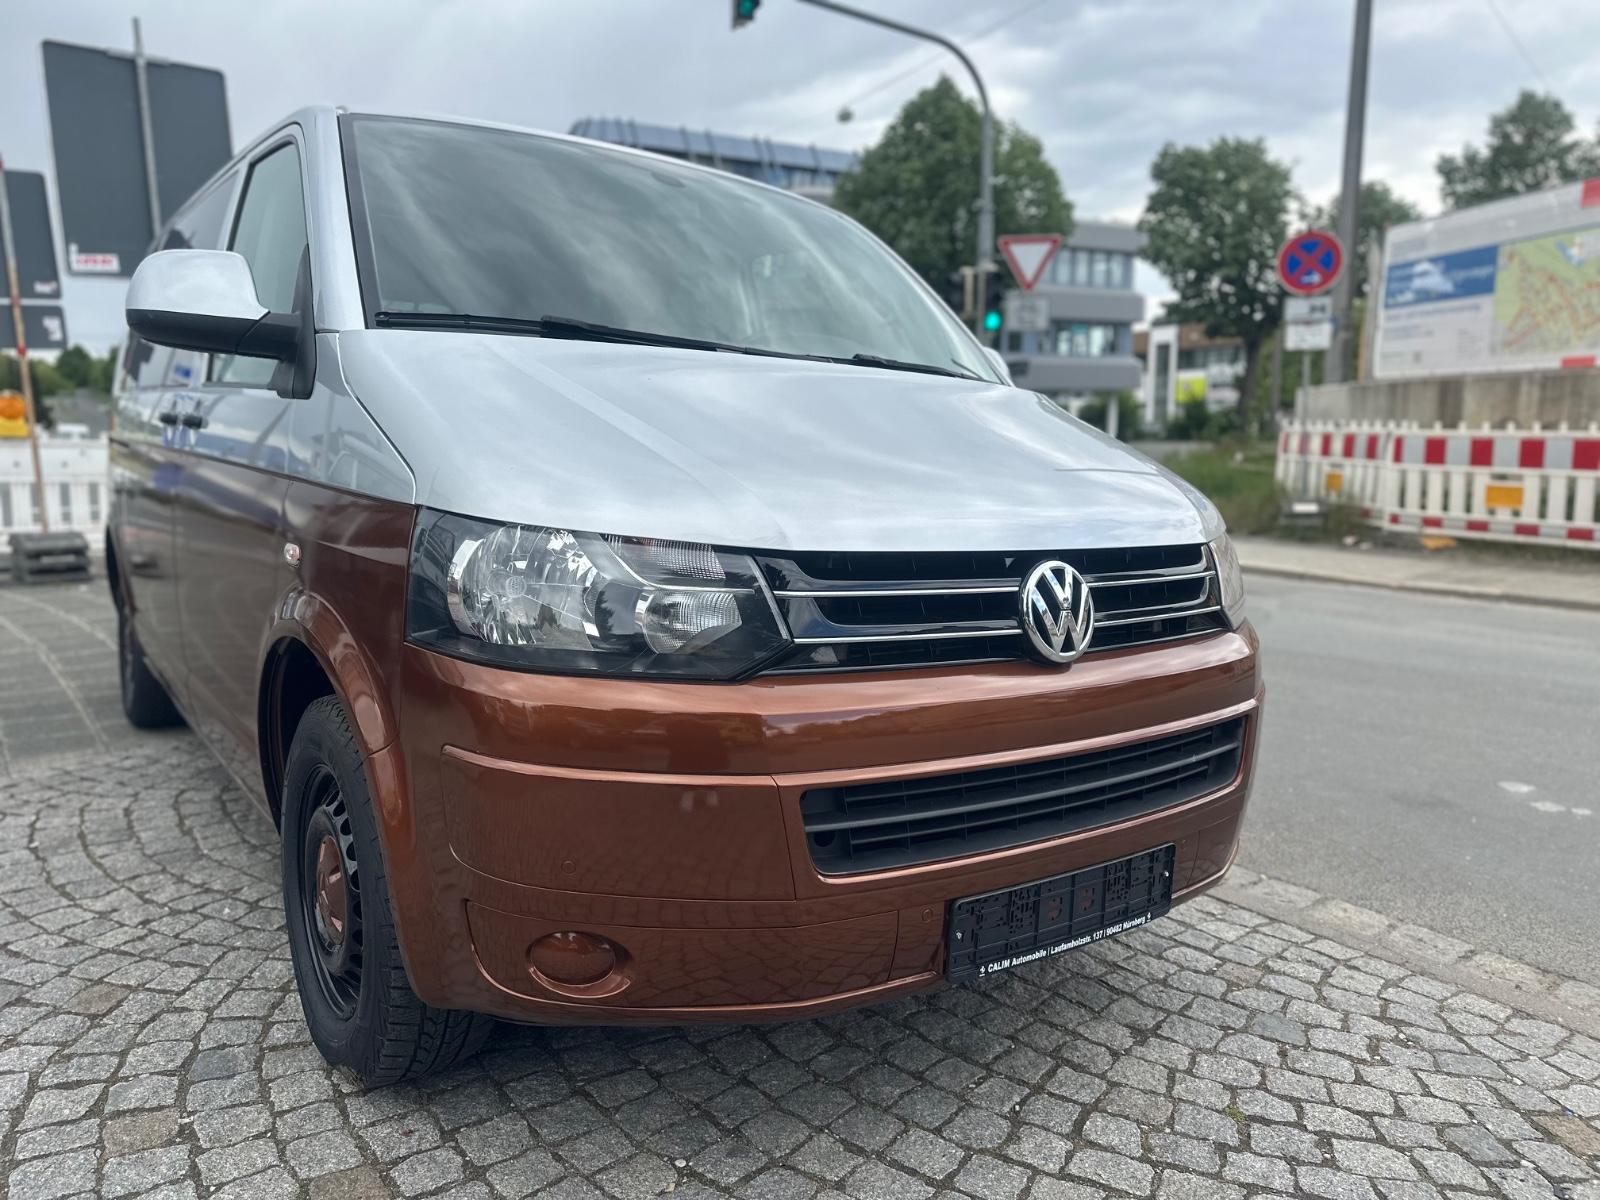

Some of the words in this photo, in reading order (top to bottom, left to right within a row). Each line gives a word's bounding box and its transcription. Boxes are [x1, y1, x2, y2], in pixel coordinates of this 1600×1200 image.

[987, 958, 1011, 973] CALIM
[1011, 949, 1047, 966] Automobile
[1050, 936, 1091, 954] Laufamholzstr.
[1093, 930, 1103, 940] 137
[1122, 916, 1146, 930] Nürnberg
